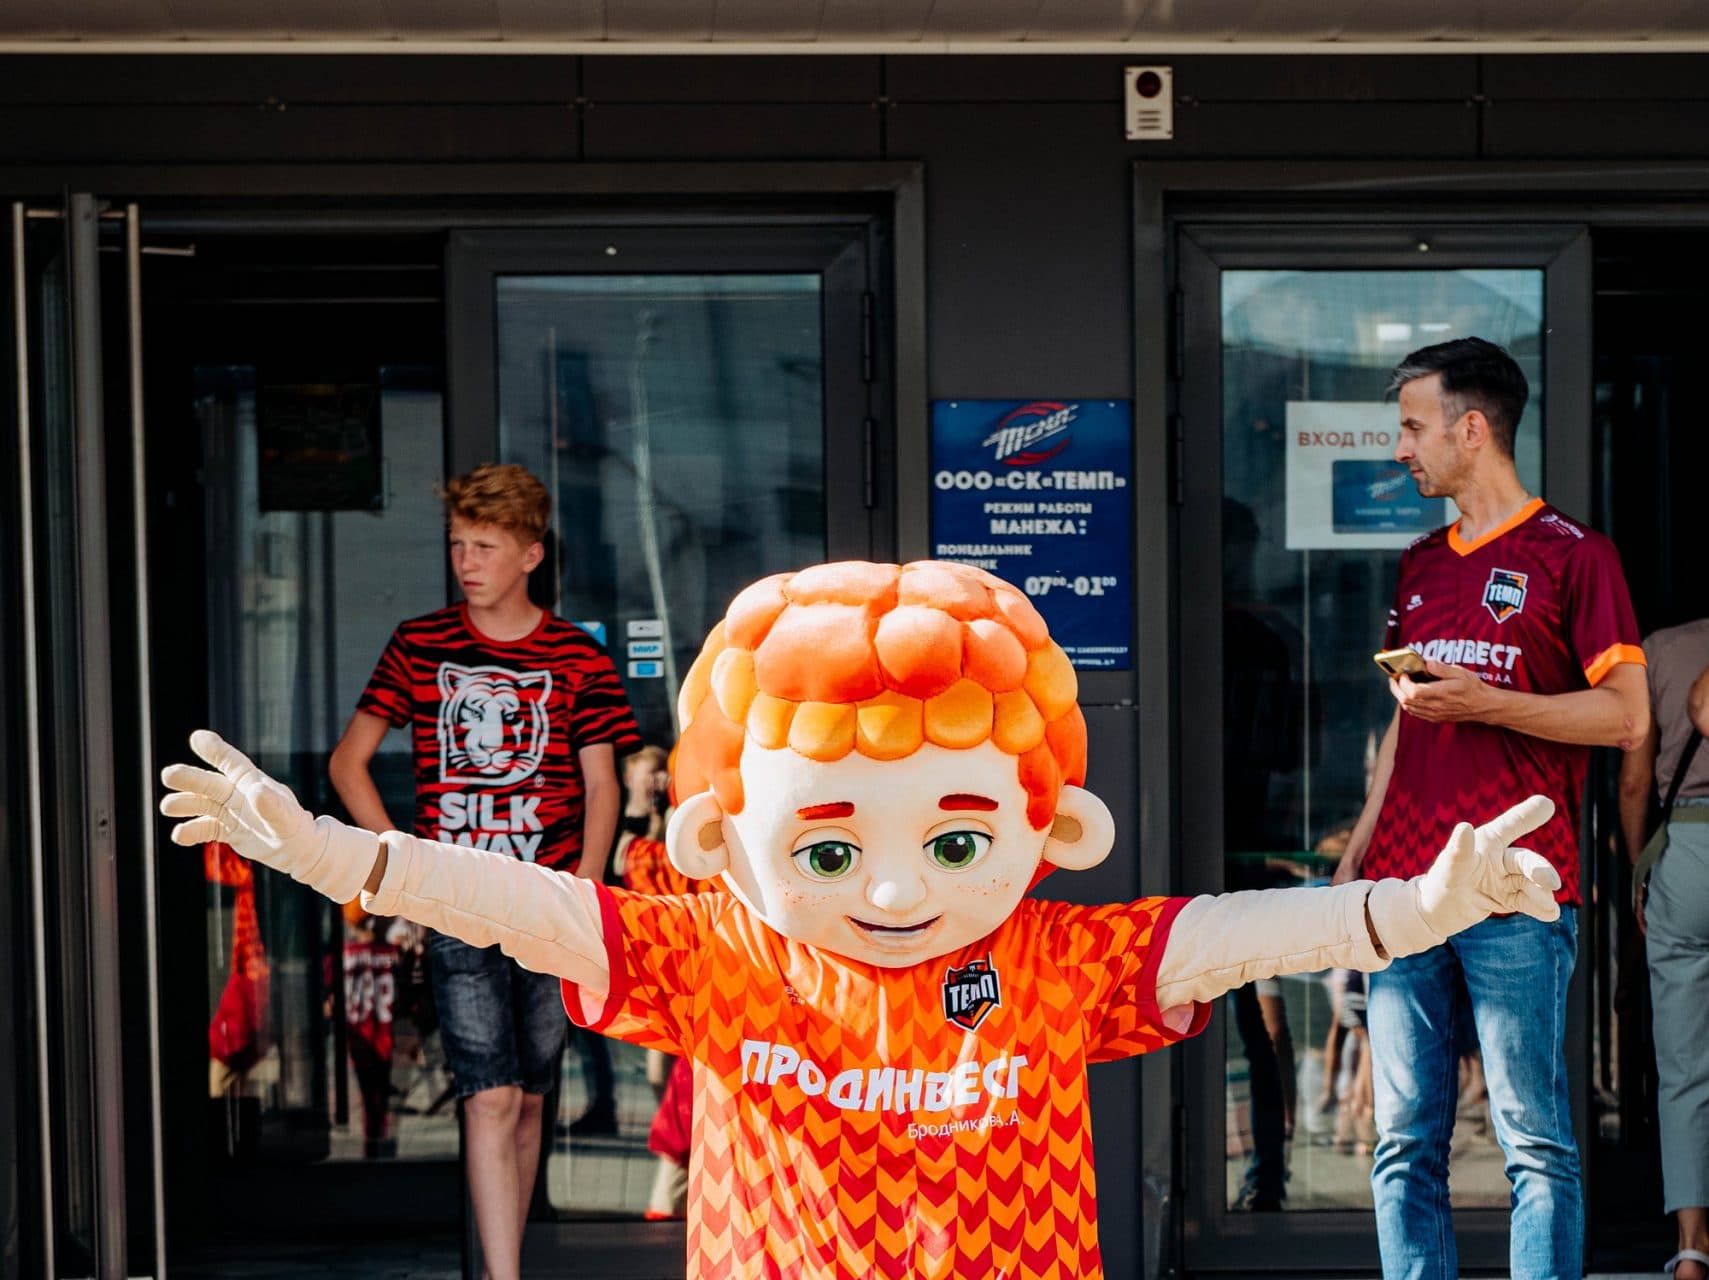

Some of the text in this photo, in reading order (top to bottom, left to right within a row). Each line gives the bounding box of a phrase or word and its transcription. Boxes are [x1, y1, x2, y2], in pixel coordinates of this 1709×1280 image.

[1297, 432, 1356, 448] ВХОД
[1362, 432, 1391, 446] ПО
[984, 503, 1093, 514] РЕЖИМ РАБОТЫ
[936, 544, 1032, 556] ПОНЕДЕЛЬНИК
[438, 791, 544, 832] SILK
